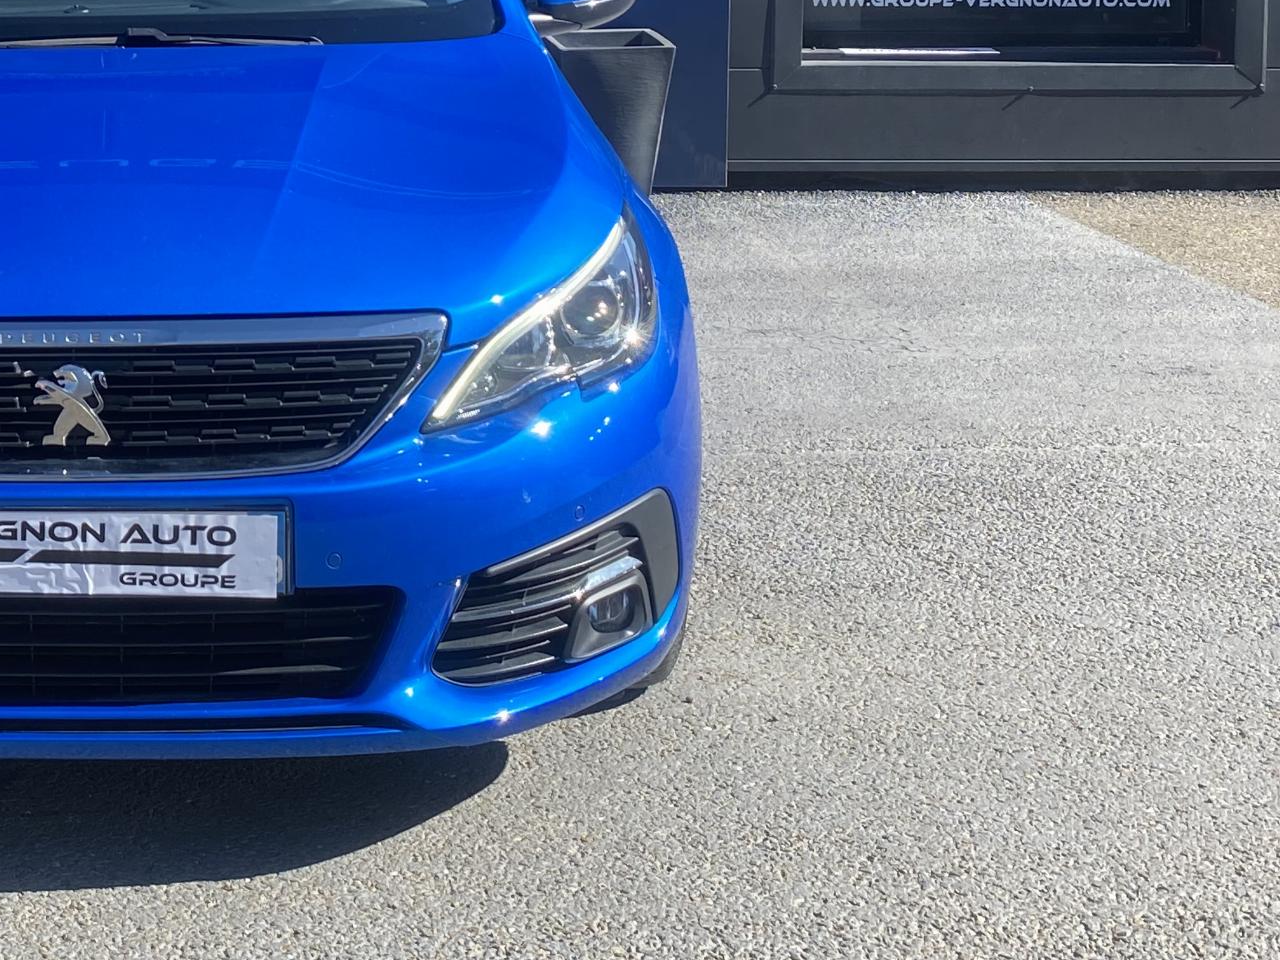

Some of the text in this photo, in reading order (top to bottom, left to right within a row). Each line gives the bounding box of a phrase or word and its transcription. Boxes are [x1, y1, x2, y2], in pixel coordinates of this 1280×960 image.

[0, 331, 145, 344] PEUGEOT
[120, 523, 237, 546] AUTO
[120, 572, 237, 589] GROUPE
